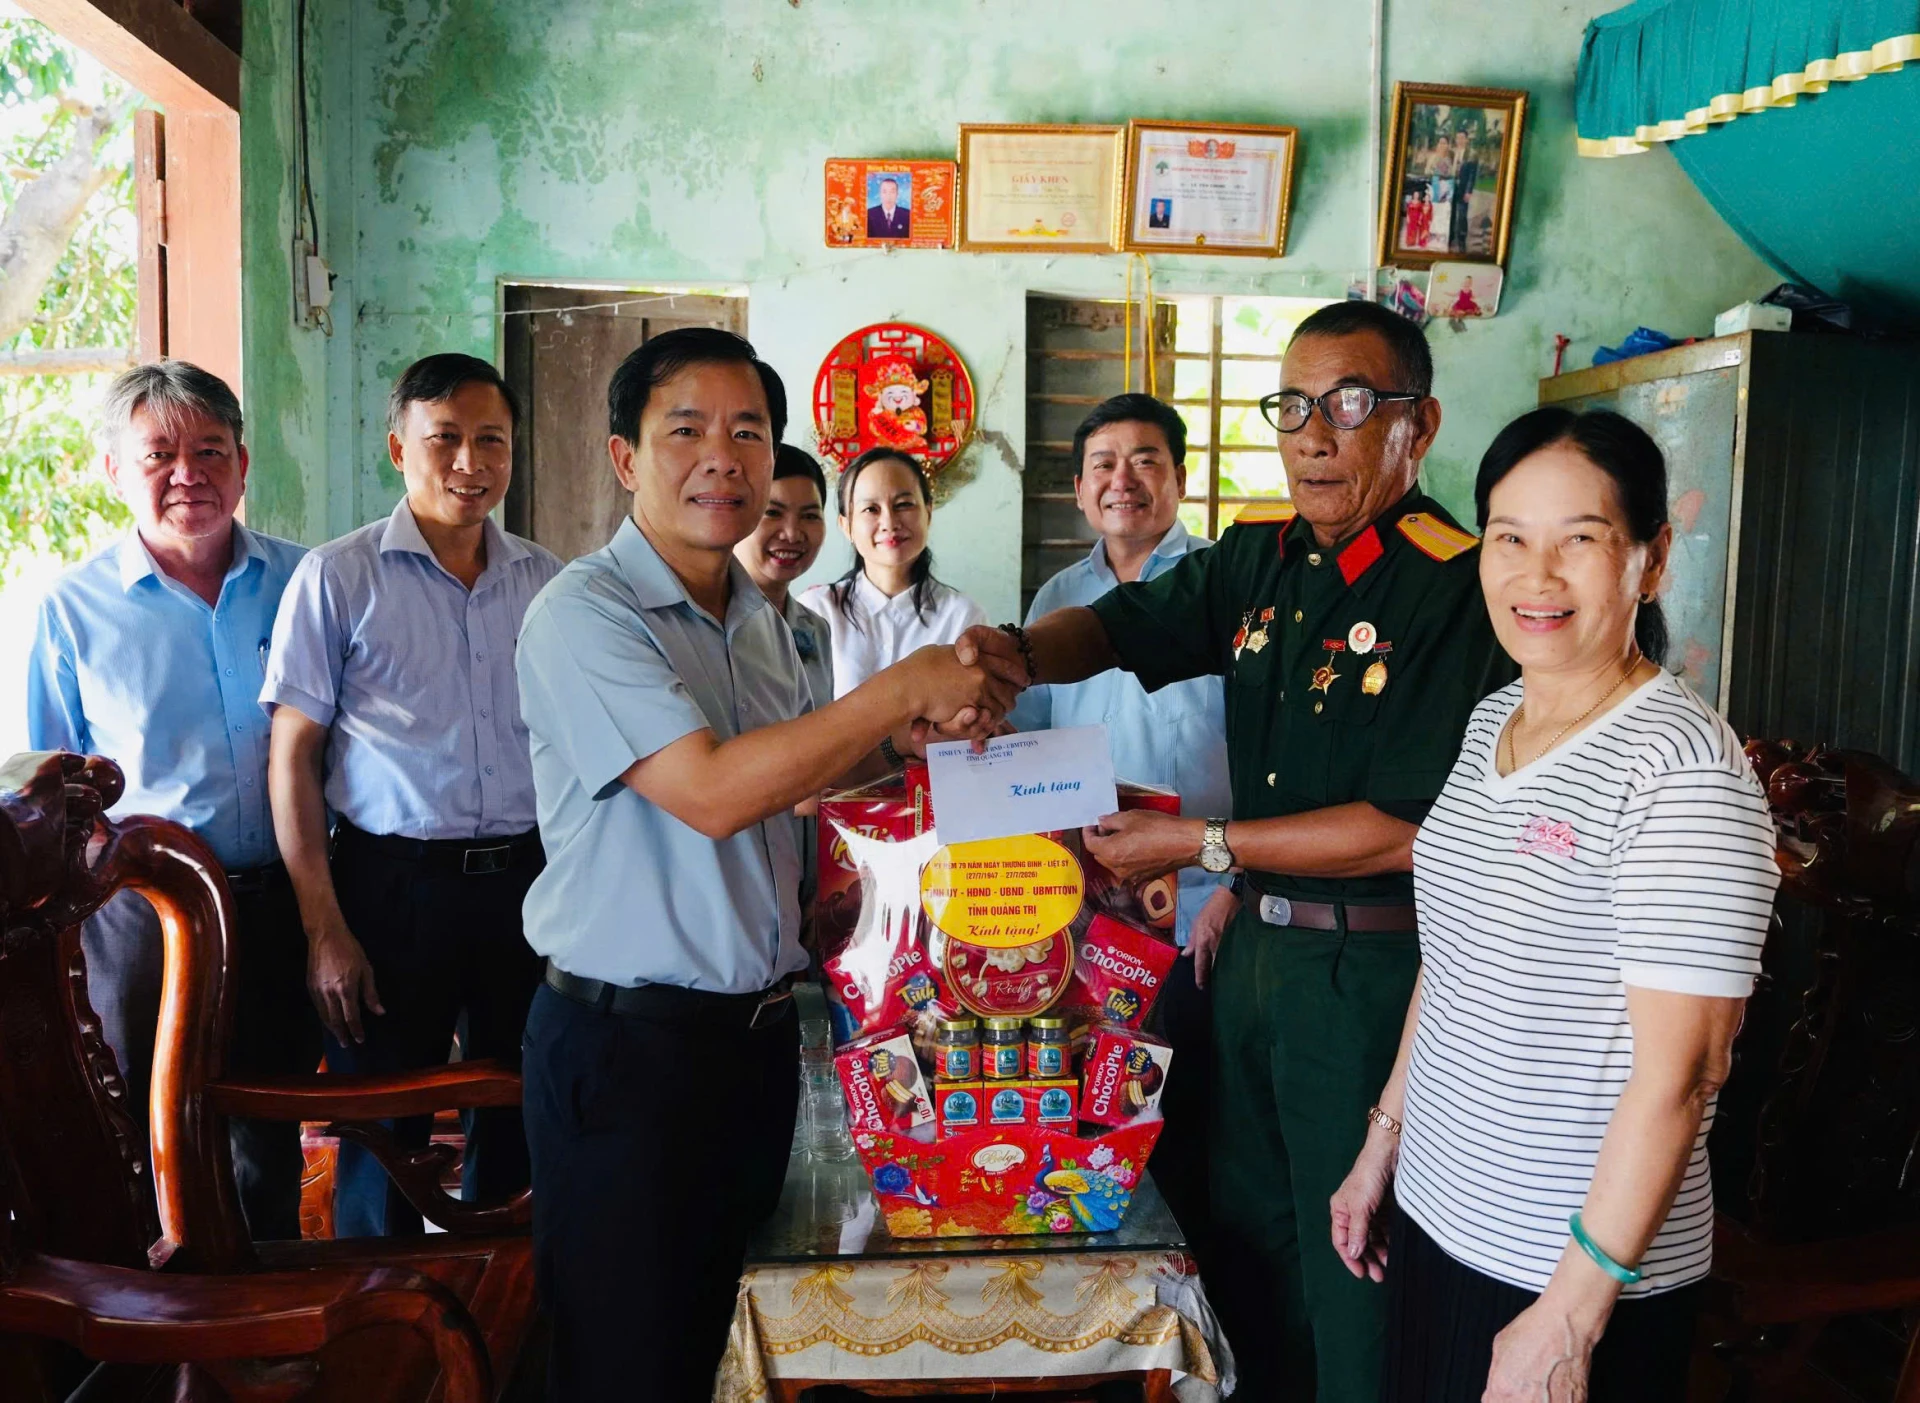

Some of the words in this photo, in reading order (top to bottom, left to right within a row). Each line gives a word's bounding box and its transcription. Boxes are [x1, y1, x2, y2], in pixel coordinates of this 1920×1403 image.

[1040, 175, 1069, 184] KHEN
[1050, 780, 1081, 794] tặng
[967, 887, 991, 897] HĐND
[1000, 886, 1024, 897] UBND
[1032, 885, 1078, 897] UBMTTQVN
[968, 903, 988, 916] TỈNH
[991, 902, 1020, 916] QUẢNG
[1023, 905, 1037, 917] TRỊ
[967, 925, 1000, 937] Kính
[1116, 950, 1143, 966] ORION
[1095, 1062, 1106, 1086] ORION
[849, 1082, 861, 1107] ORION
